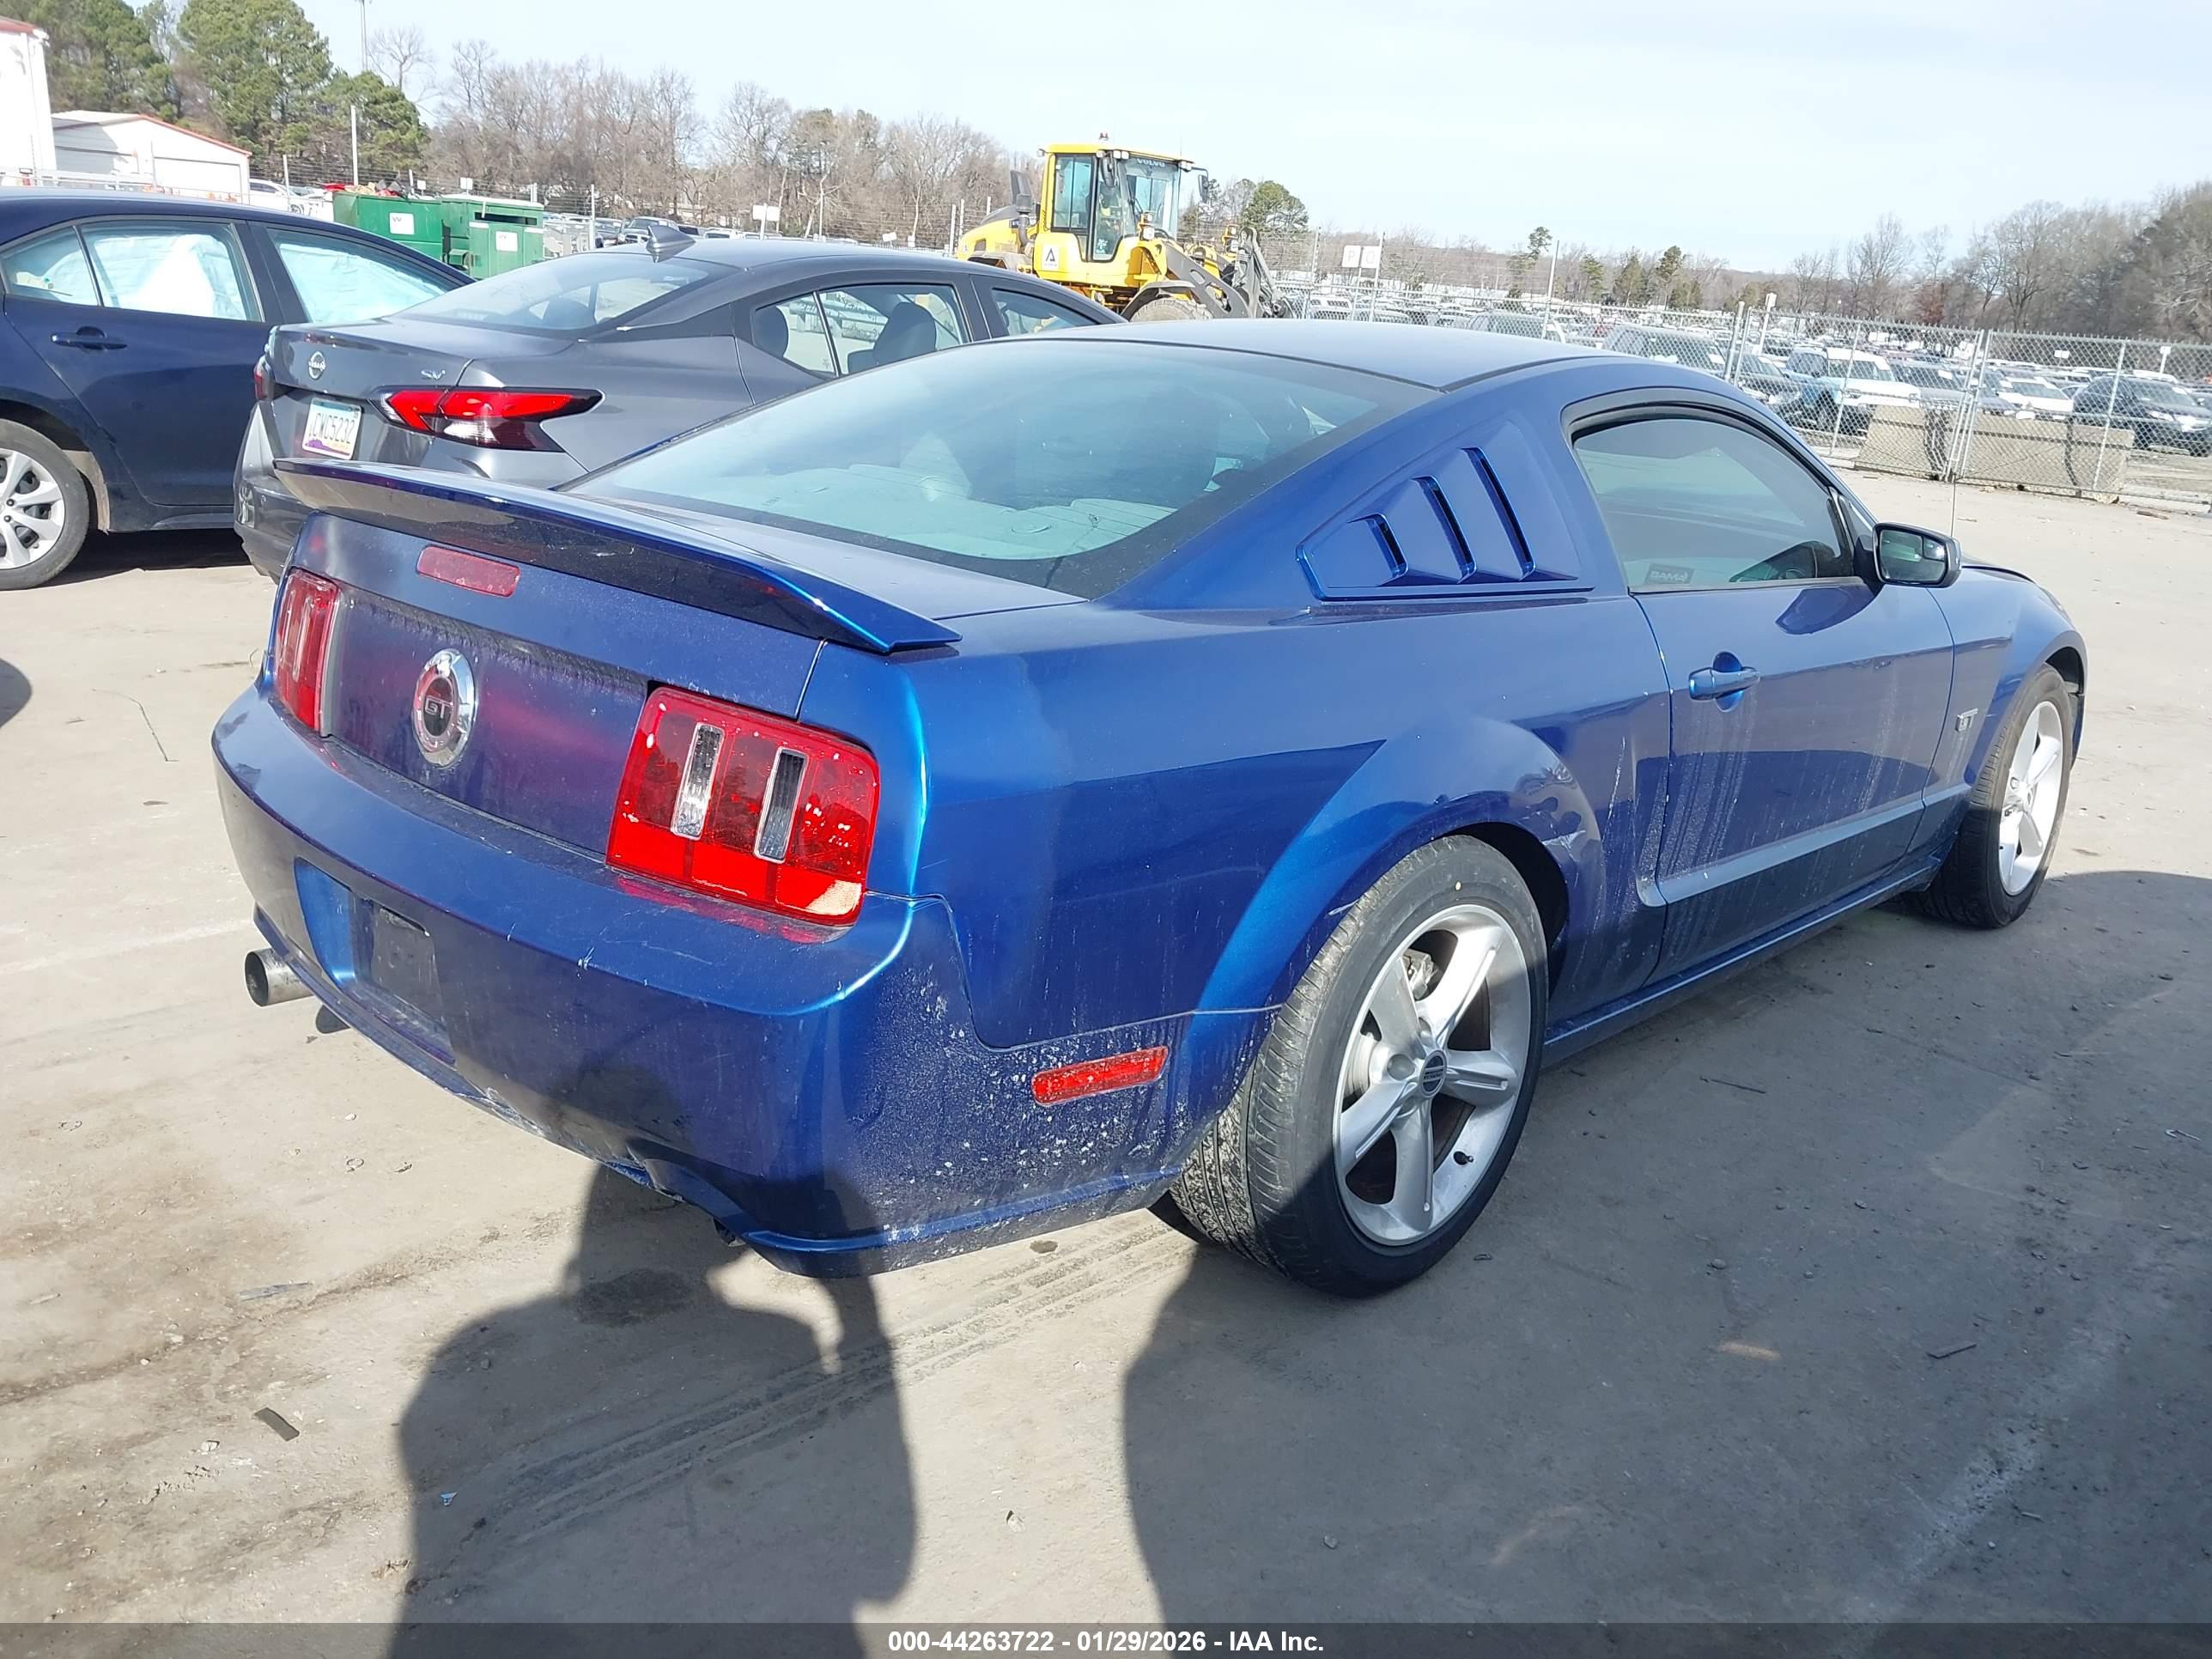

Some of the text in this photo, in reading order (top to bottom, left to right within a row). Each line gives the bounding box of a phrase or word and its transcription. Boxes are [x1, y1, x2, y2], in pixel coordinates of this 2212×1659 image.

[1136, 158, 1165, 167] VOLVO
[1347, 250, 1356, 261] P
[421, 369, 446, 380] SV
[425, 695, 453, 720] GT
